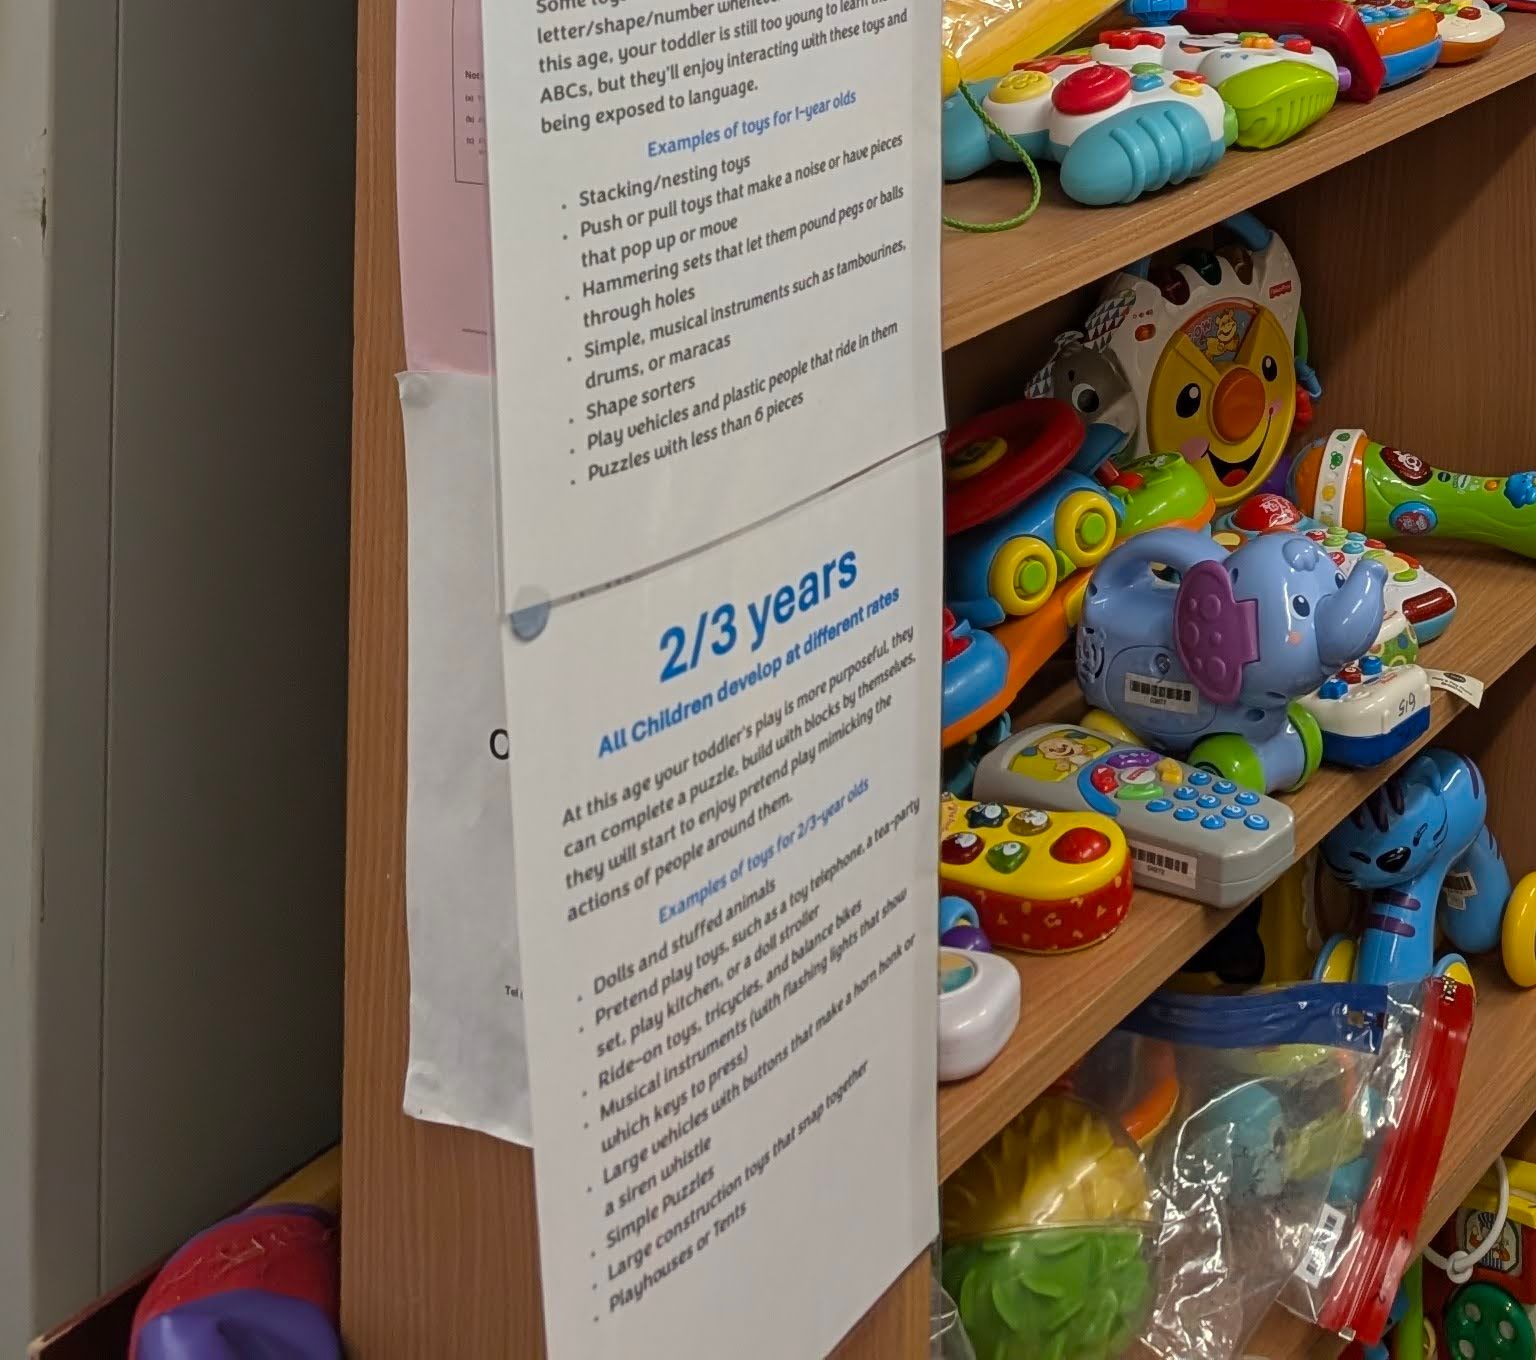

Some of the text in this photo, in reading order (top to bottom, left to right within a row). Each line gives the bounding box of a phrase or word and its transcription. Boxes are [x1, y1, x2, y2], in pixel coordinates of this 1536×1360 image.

[540, 79, 759, 135] being exposed to language.
[647, 90, 857, 158] Examples of toys for 1-year olds
[598, 587, 900, 759] All Children develop at different rates
[659, 550, 858, 683] 2/3 years
[562, 806, 585, 827] At
[587, 788, 619, 816] this
[622, 778, 652, 807] age
[653, 757, 690, 793] your
[691, 720, 754, 766] toddler's
[755, 705, 783, 742] play
[784, 698, 795, 720] is
[797, 682, 828, 711] more
[890, 624, 915, 655] they
[606, 1166, 715, 1249] Simple Puzzles
[607, 1201, 748, 1314] Playhouses or Tents
